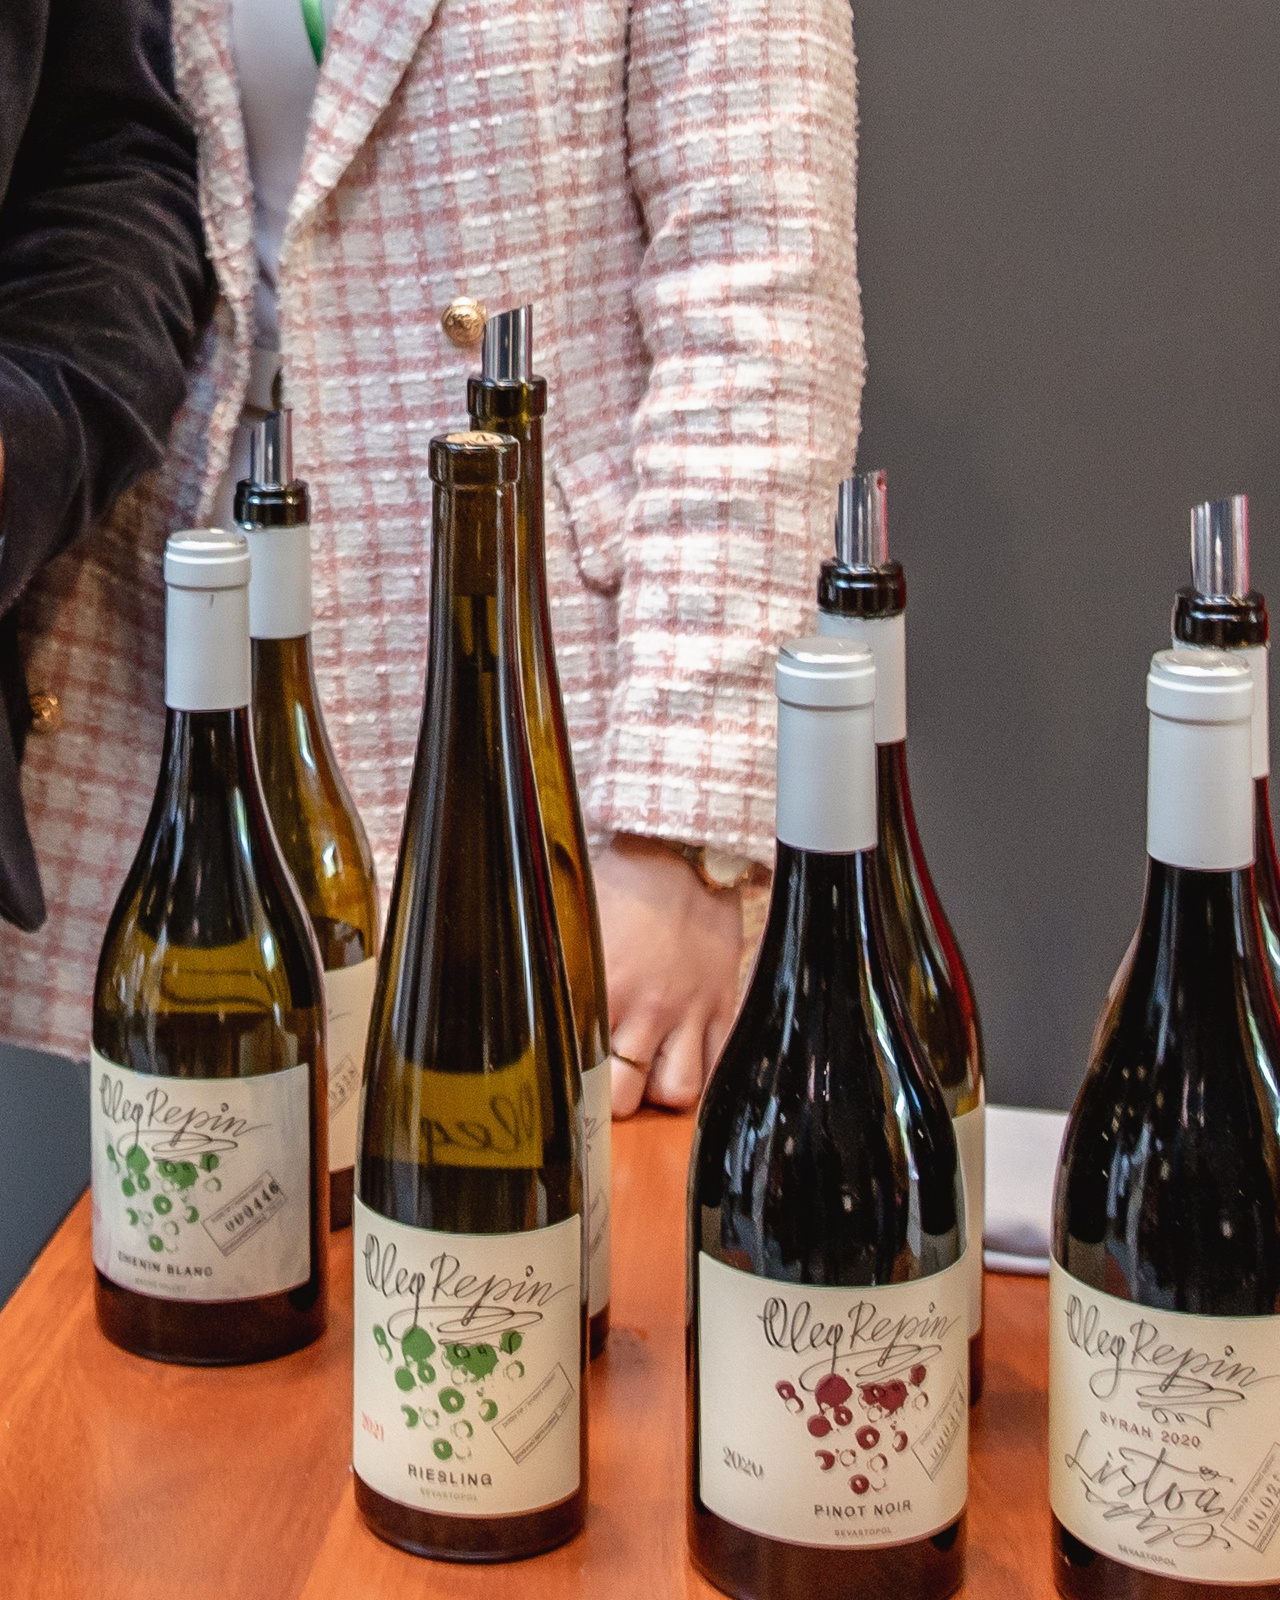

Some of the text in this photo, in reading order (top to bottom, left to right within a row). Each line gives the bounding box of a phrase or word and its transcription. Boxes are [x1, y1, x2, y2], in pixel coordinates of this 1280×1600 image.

[99, 1073, 273, 1148] Oleg Repin
[166, 1264, 213, 1278] BLANC
[363, 1233, 575, 1326] Oleg Repin
[757, 1297, 962, 1374] Oleg Repin
[1065, 1295, 1280, 1396] Oleg Repin
[1099, 1411, 1201, 1448] SYRAH 2020
[408, 1463, 493, 1486] RIESLING
[722, 1446, 764, 1479] 2020
[814, 1499, 912, 1518] PINOT NOIR
[834, 1527, 892, 1537] SEVASTOPOL
